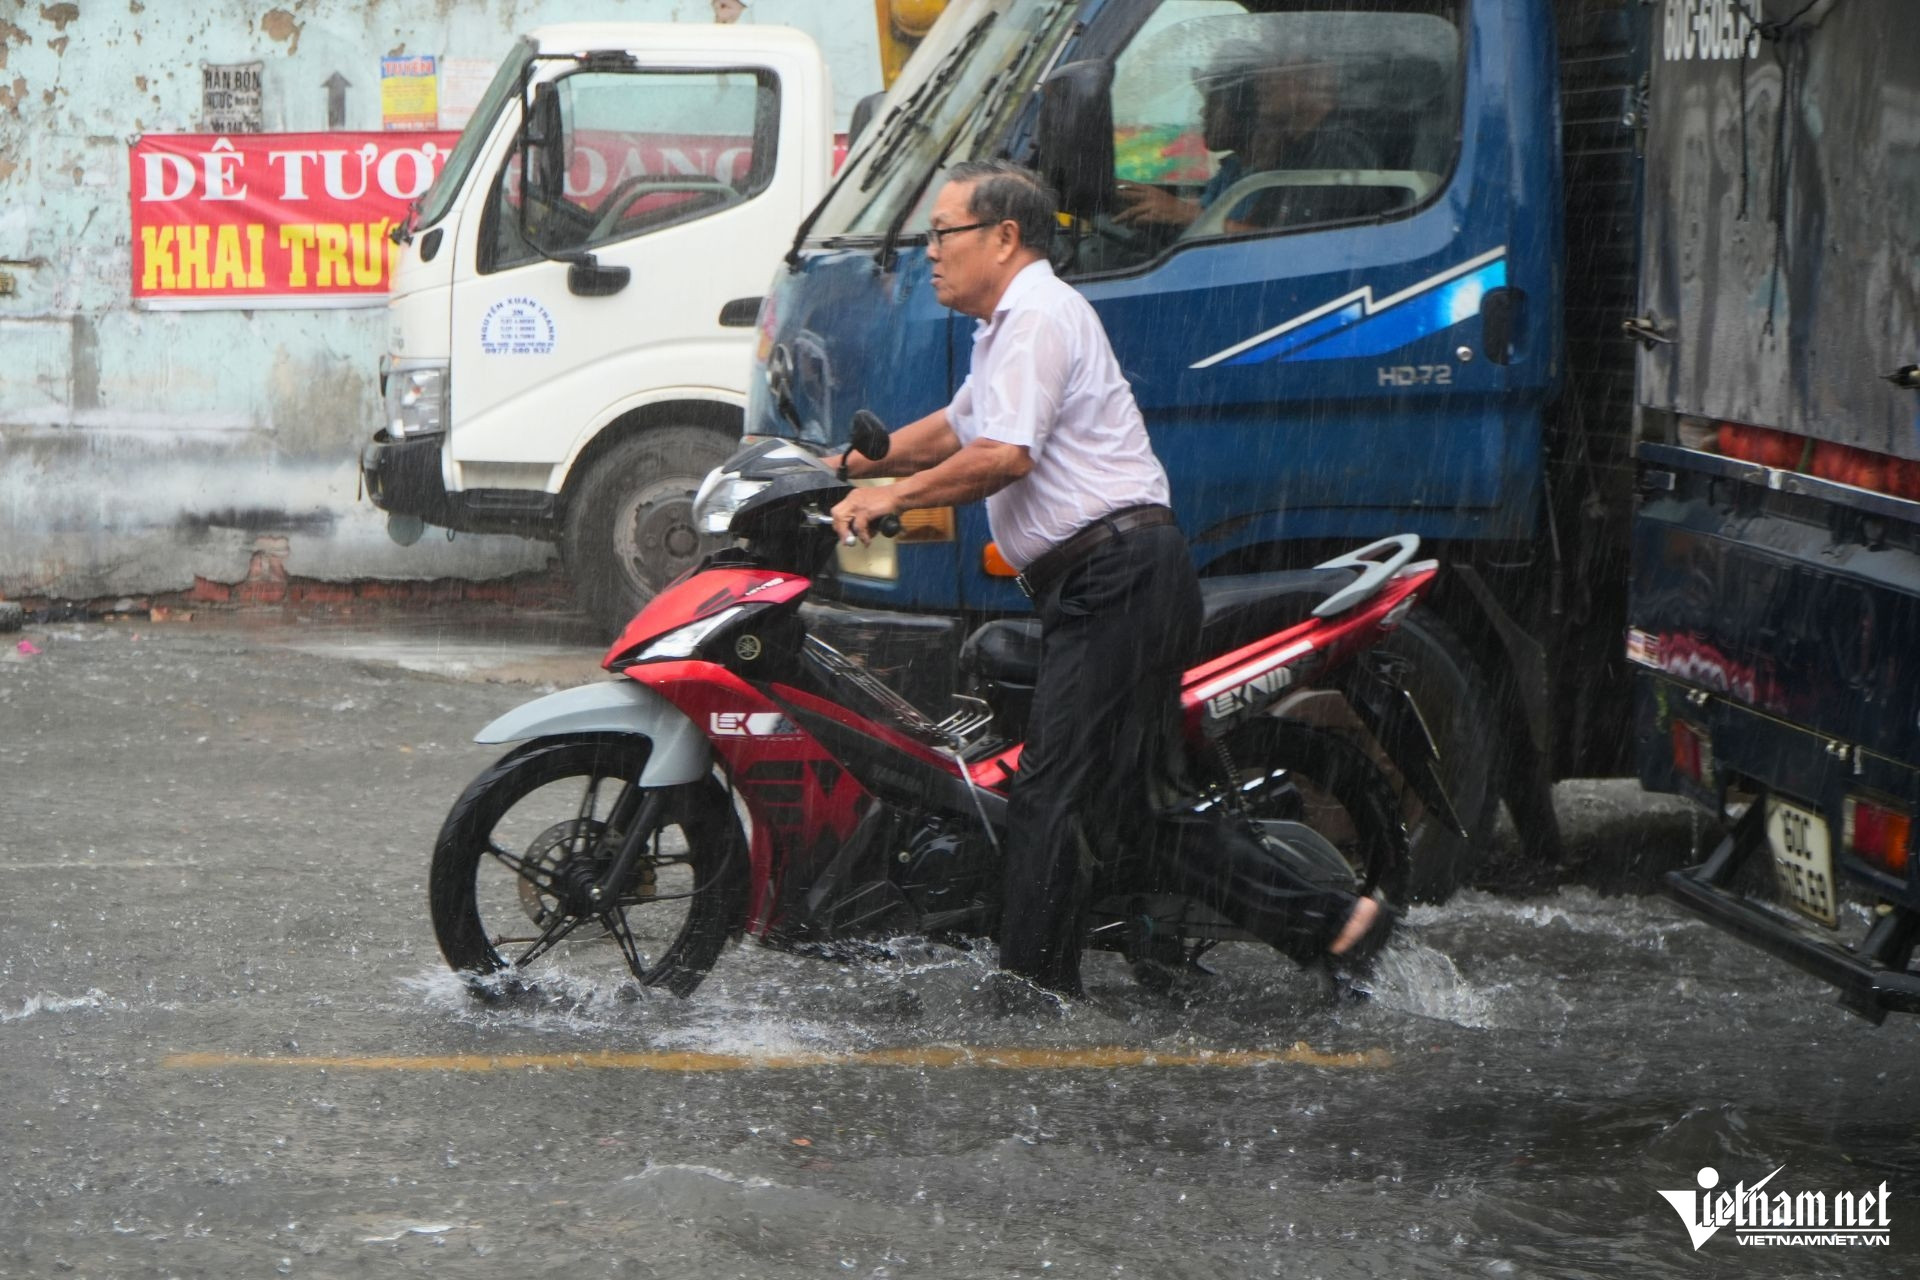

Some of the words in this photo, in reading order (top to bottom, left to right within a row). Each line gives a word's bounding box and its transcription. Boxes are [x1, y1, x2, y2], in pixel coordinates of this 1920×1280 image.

[139, 138, 248, 202] DÊ
[268, 142, 453, 201] TƯƠ
[141, 224, 266, 290] KHAI
